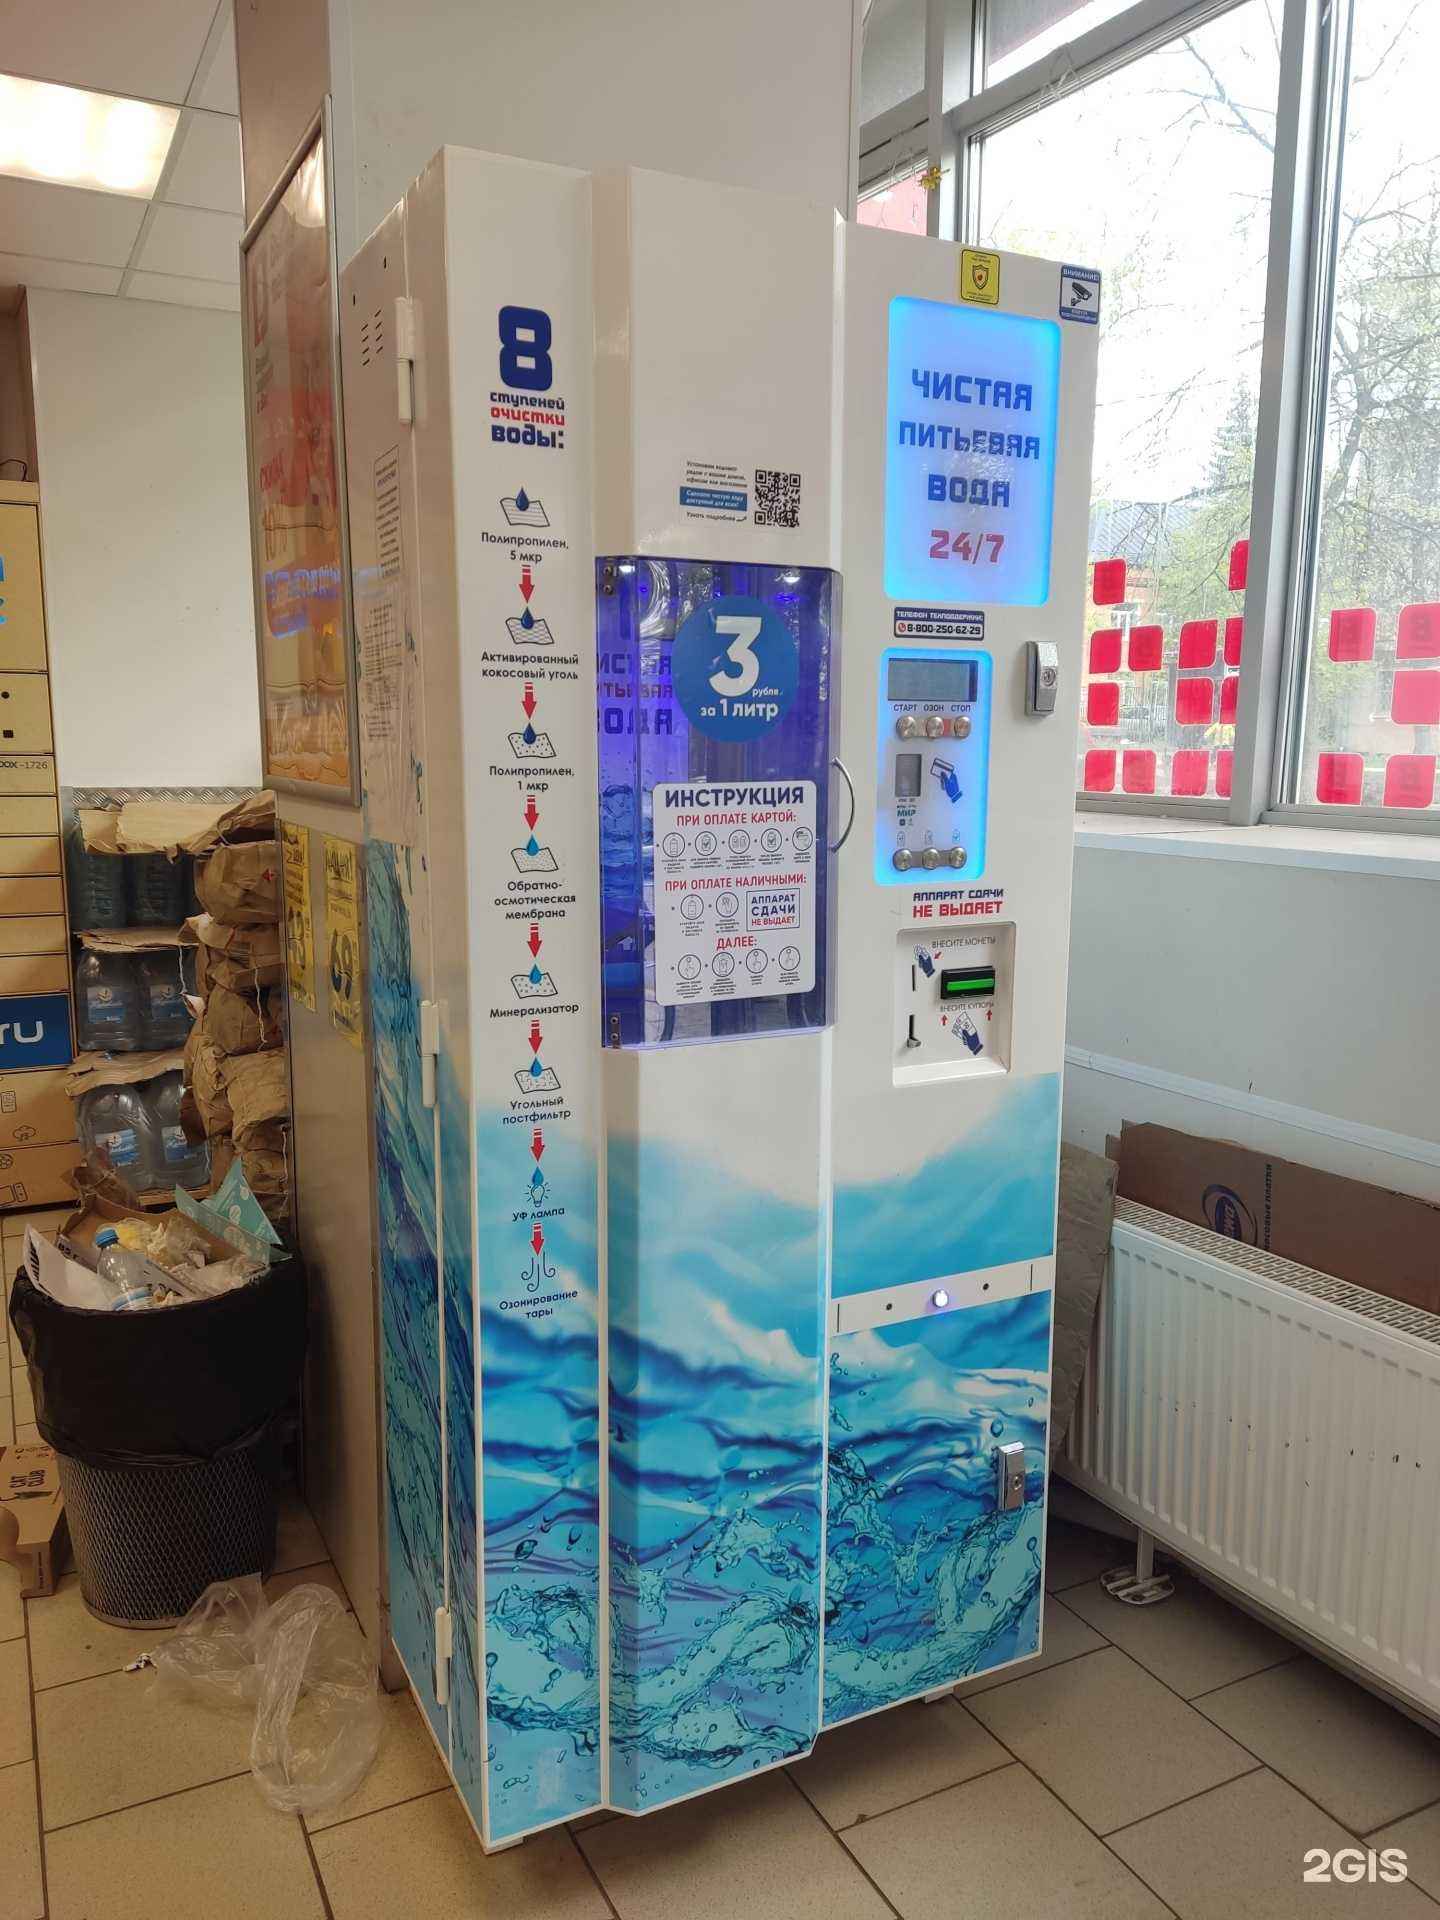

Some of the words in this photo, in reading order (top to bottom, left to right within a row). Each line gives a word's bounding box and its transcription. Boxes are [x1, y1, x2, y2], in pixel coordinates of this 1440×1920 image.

[498, 305, 552, 391] 8
[911, 368, 1033, 411] ЧИСТАЯ
[490, 391, 565, 411] ступеней
[490, 406, 565, 426] очистки
[491, 424, 565, 449] воды:
[898, 420, 1040, 460] ПИТЬЕВАЯ
[927, 473, 1011, 508] ВОДА
[481, 532, 569, 550] Полипропилен,
[929, 529, 1005, 565] 24/7
[510, 551, 517, 561] 5
[519, 552, 542, 563] мкр
[481, 651, 579, 665] Активированный
[708, 615, 763, 697] 3
[482, 668, 545, 679] кокосовый
[549, 670, 579, 681] уголь
[700, 706, 716, 716] за
[719, 699, 728, 716] 1
[732, 701, 779, 722] литр
[893, 704, 917, 712] СТАРТ
[923, 704, 945, 712] ОЗОН
[951, 704, 971, 712] СТОП
[489, 766, 575, 778] Полипропилен,
[517, 781, 522, 790] 1
[526, 782, 549, 792] мкр
[665, 786, 804, 808] ИНСТРУКЦИЯ
[676, 814, 700, 827] ПРИ
[704, 812, 747, 826] ОПЛАТЕ
[751, 809, 797, 824] КАРТОЙ:
[507, 881, 563, 893] Обратно-
[665, 880, 687, 892] ПРИ
[690, 877, 732, 890] ОПЛАТЕ
[735, 873, 807, 888] НАЛИЧНЫМИ:
[494, 894, 576, 906] осмотическая
[751, 894, 796, 905] АППАРАТ
[913, 889, 965, 902] АППАРАТ
[968, 888, 1004, 899] СДАЧИ
[505, 908, 566, 920] мембрана
[751, 904, 796, 917] СДАЧИ
[912, 904, 933, 919] НЕ
[939, 901, 1003, 917] ВЫДАЕТ
[751, 919, 762, 927] НЕ
[763, 917, 796, 926] ВЫДАЕТ
[716, 935, 758, 951] ДАЛЕЕ:
[489, 1003, 580, 1018] Минерализатор
[510, 1096, 564, 1110] Угольный
[502, 1110, 571, 1125] постфильтр
[530, 1207, 565, 1218] лампа
[499, 1290, 578, 1310] Озонирование
[526, 1307, 553, 1319] тары
